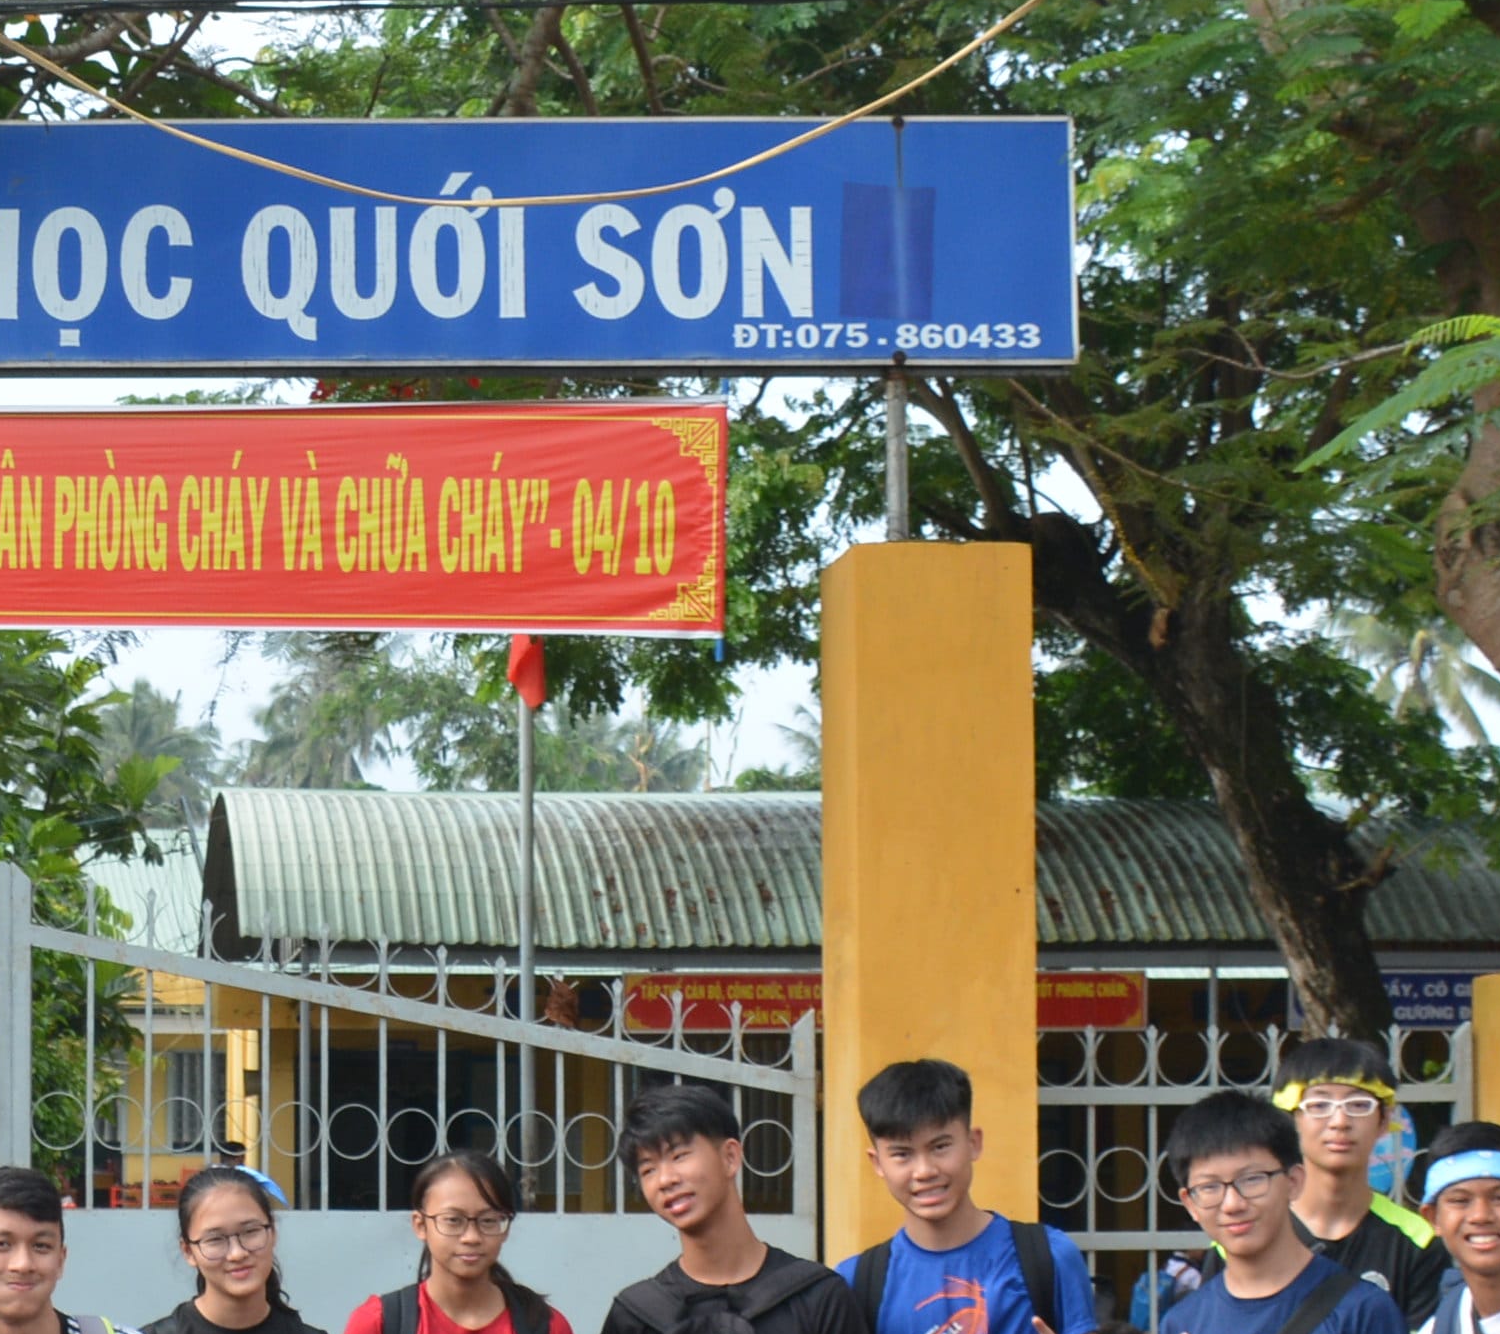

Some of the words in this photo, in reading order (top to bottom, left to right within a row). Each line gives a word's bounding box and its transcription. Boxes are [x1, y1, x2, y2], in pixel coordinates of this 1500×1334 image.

[241, 172, 527, 341] QUỚI
[573, 186, 813, 319] SƠN
[895, 323, 1041, 349] 860433
[53, 449, 168, 572] PHÒNG
[178, 450, 270, 572] CHÁY
[280, 450, 323, 571] VÀ
[335, 452, 428, 574] CHỮA
[573, 477, 676, 576] 04/10
